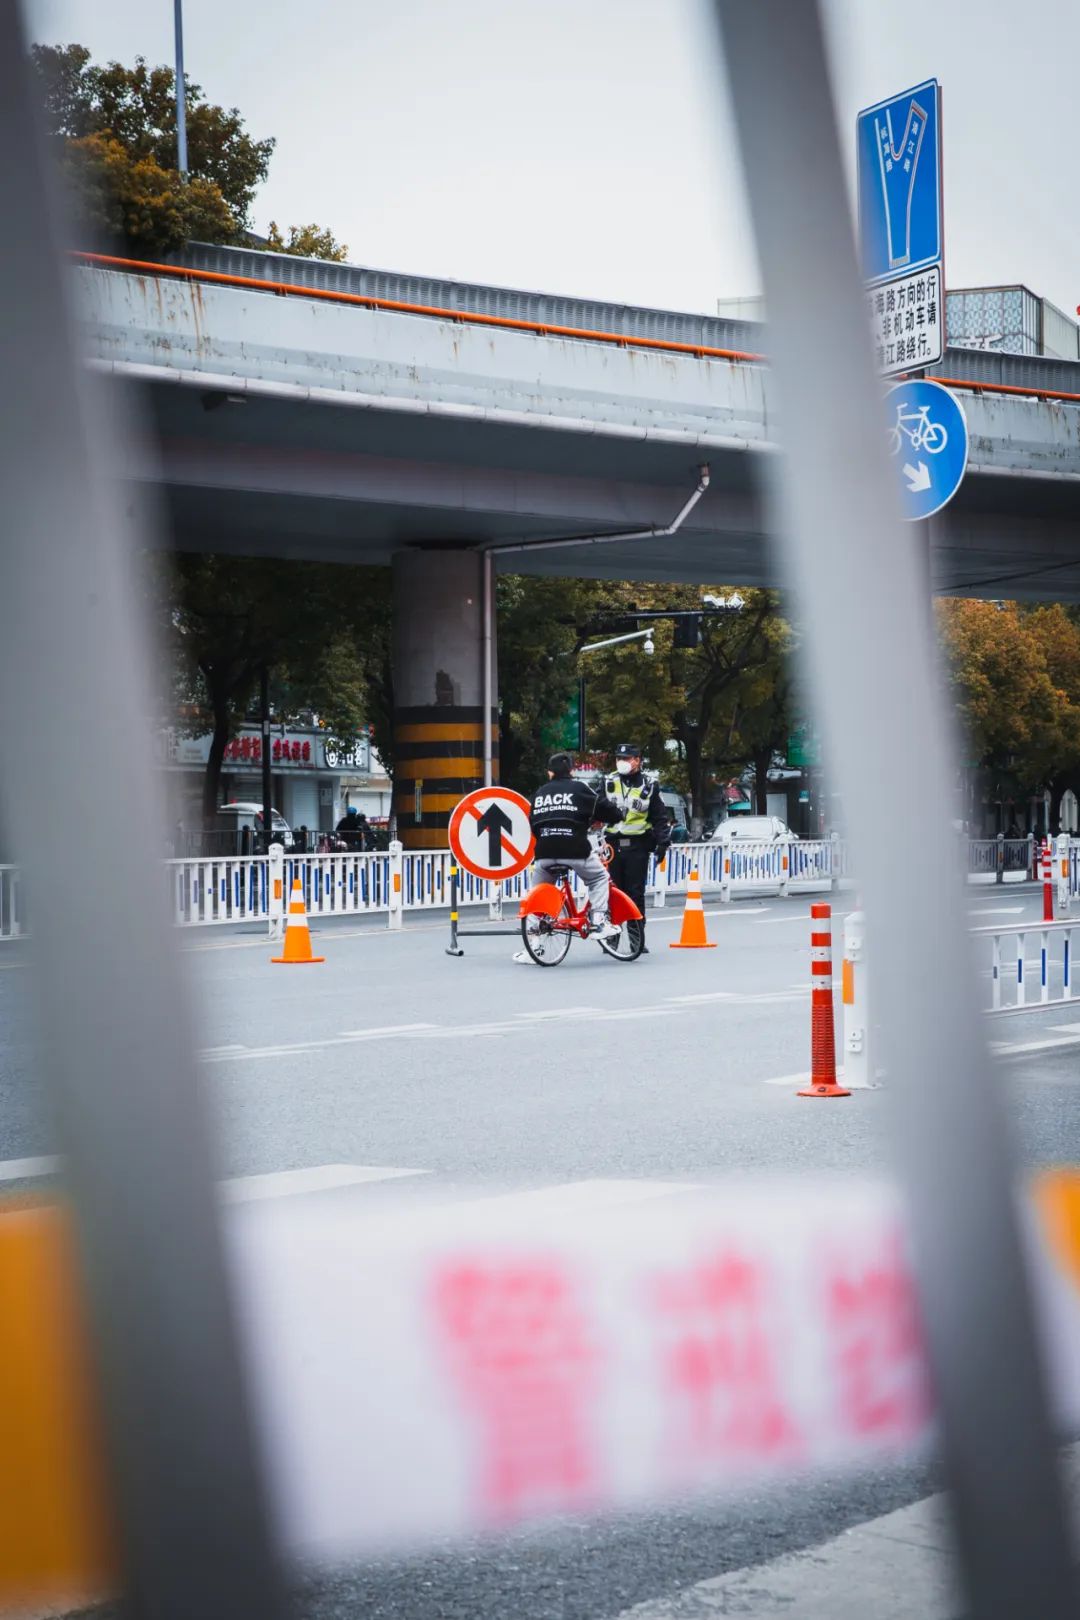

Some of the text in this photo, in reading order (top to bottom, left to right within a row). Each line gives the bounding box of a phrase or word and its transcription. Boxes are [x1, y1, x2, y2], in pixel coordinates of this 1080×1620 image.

[866, 276, 936, 315] 海路方向的行
[534, 793, 574, 808] BACK
